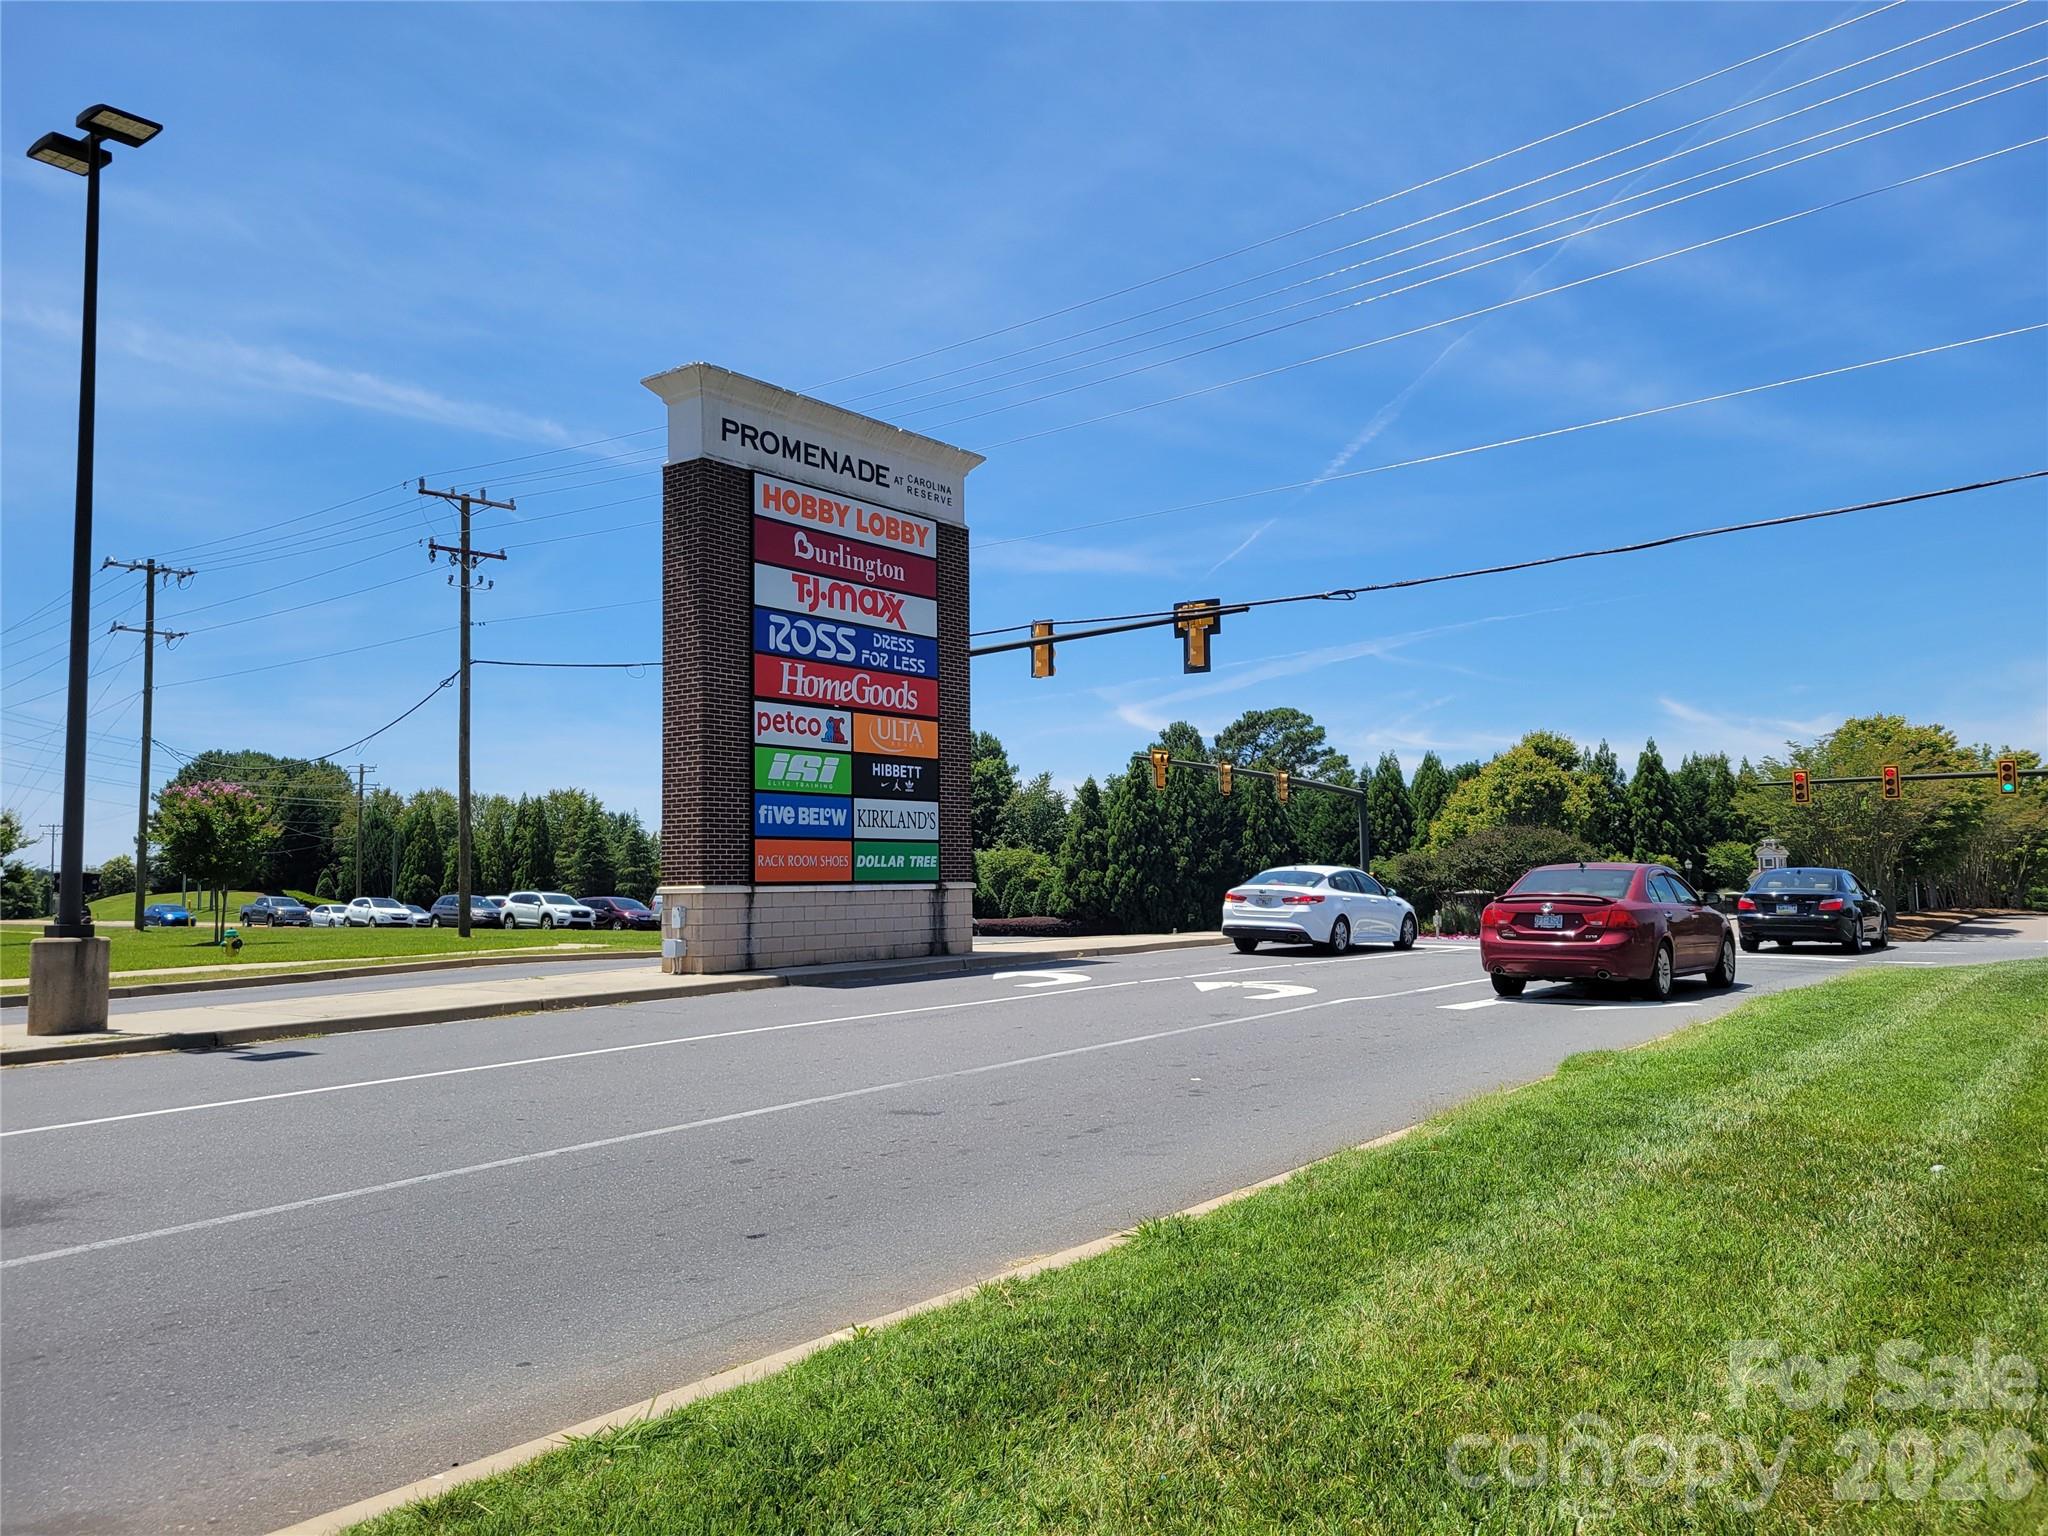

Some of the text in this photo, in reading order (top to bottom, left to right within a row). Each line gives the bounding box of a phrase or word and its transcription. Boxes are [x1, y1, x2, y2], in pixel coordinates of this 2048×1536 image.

[721, 417, 905, 489] PROMENADE AT
[906, 485, 953, 507] RESERVE
[907, 474, 953, 496] CAROLINA
[762, 483, 930, 548] HOBBY LOBBY
[793, 531, 906, 582] Burlington
[768, 614, 857, 662] ROSS
[873, 633, 915, 654] DRESS
[861, 649, 926, 674] FOR LESS
[778, 661, 919, 710] HomeGoods
[757, 711, 822, 737] petco
[876, 717, 924, 744] ULTA
[872, 762, 922, 779] HIBBETT
[795, 781, 833, 790] TRAINING
[856, 808, 937, 830] KIRKLAND'S
[757, 855, 849, 868] RACK ROOM SHOES
[856, 855, 937, 868] DOLLAR TREE
